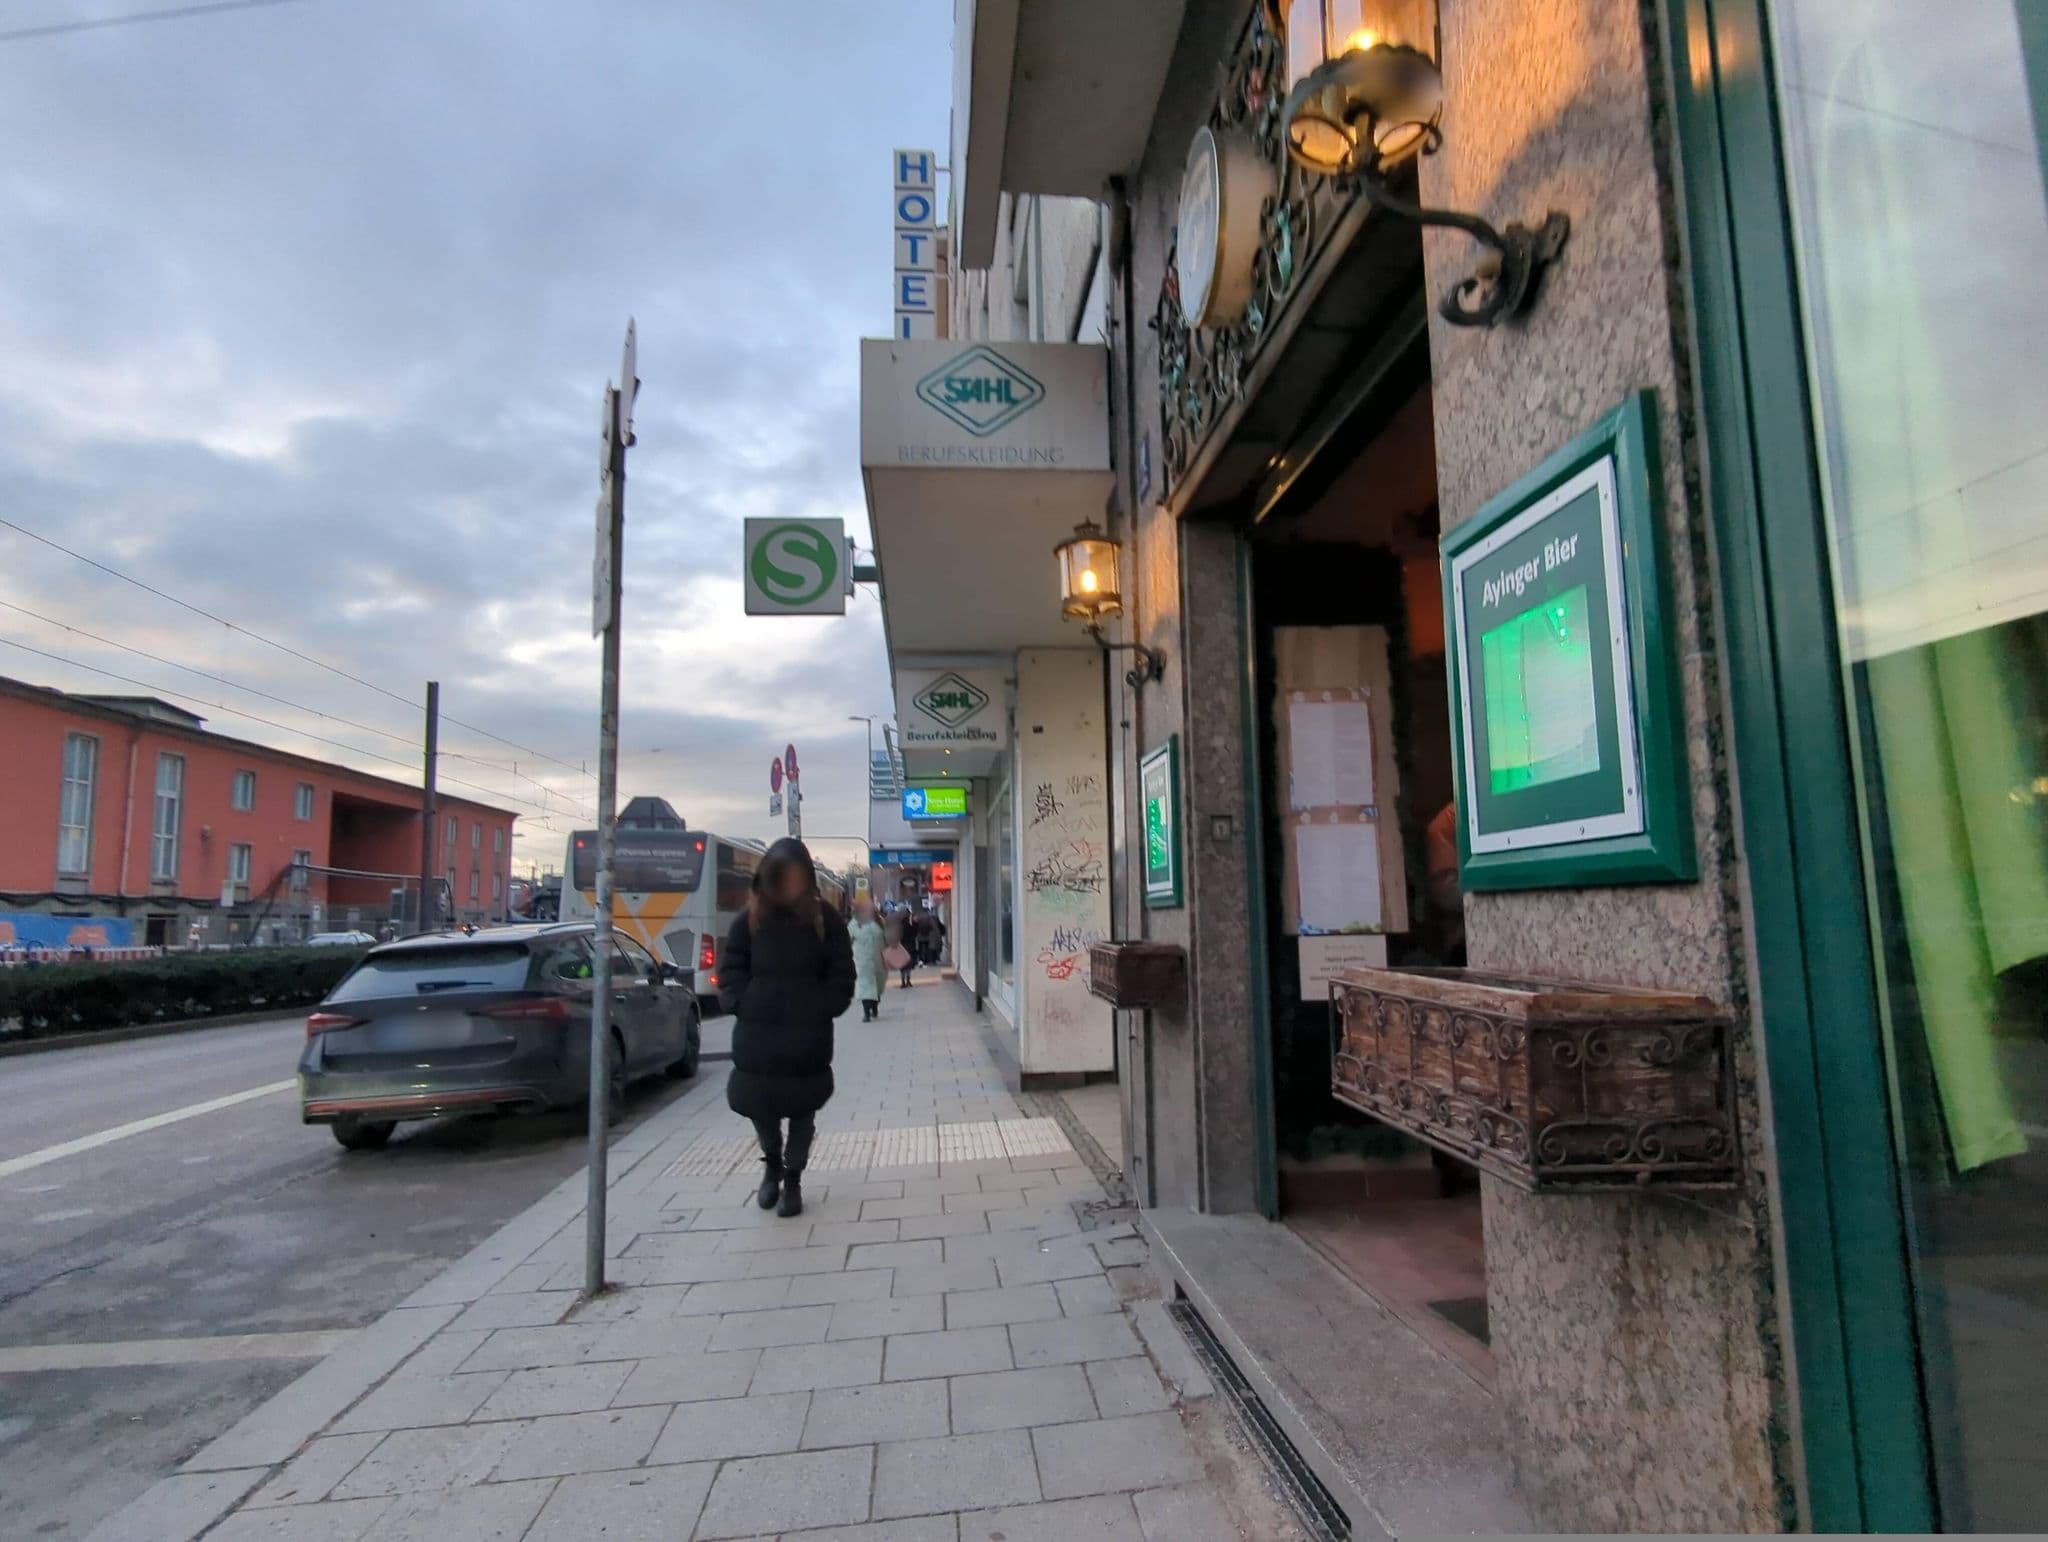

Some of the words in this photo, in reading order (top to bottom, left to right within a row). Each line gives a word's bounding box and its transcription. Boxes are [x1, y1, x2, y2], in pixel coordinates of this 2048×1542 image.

[943, 375, 1019, 405] STAHL
[897, 445, 1064, 464] BERUFSKLEIDUNG
[764, 530, 824, 598] S
[1482, 556, 1540, 609] Ayinger
[1544, 533, 1578, 572] Bier
[928, 691, 975, 710] STAHL
